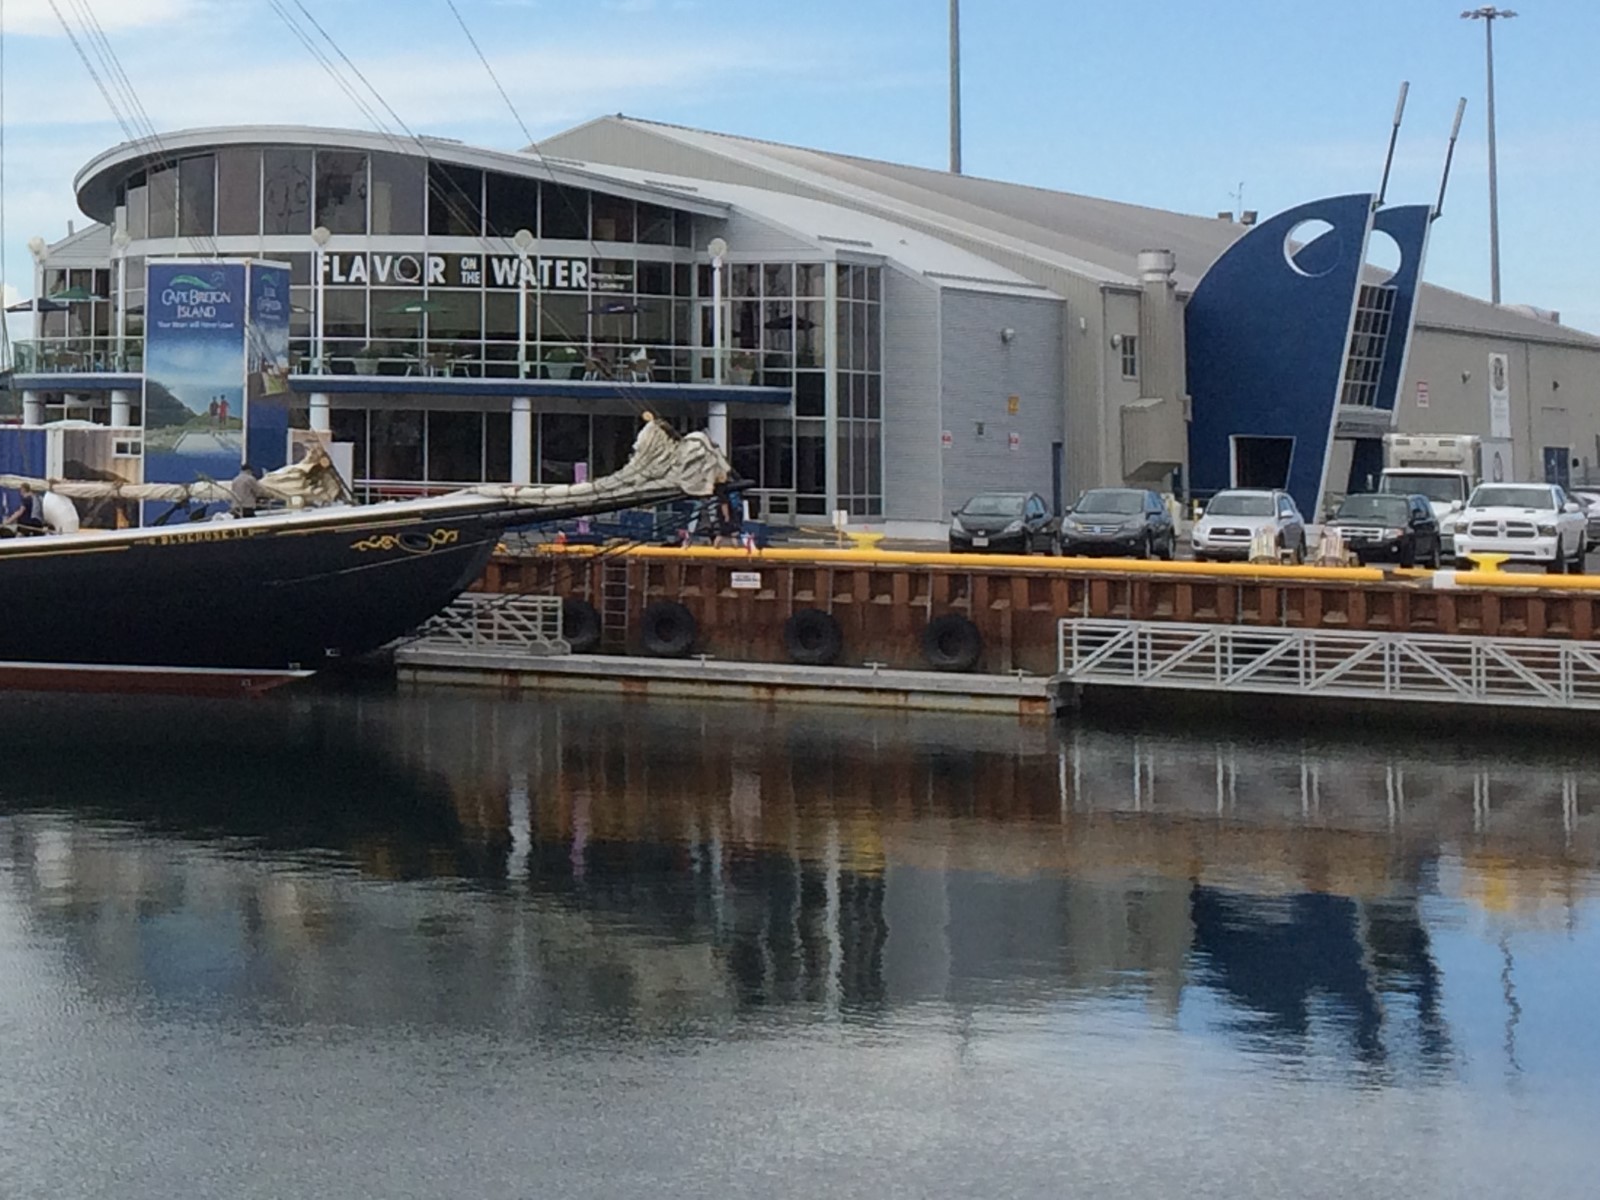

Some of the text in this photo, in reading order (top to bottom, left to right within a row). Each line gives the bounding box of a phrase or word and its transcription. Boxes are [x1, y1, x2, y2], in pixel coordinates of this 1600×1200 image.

[317, 255, 446, 284] FLAVOR
[461, 257, 477, 271] ON
[491, 257, 588, 288] WATER
[461, 271, 481, 285] THE
